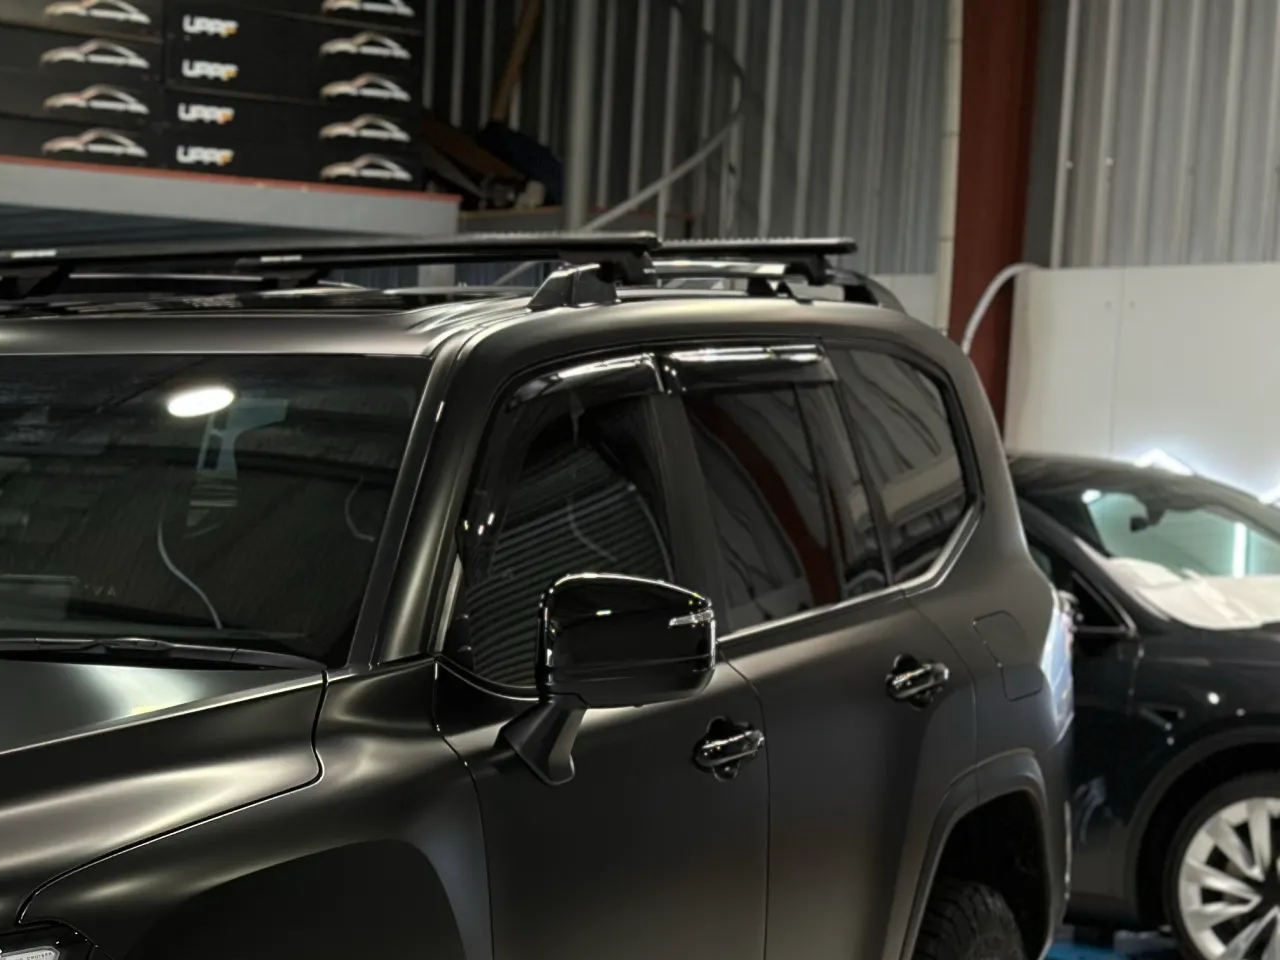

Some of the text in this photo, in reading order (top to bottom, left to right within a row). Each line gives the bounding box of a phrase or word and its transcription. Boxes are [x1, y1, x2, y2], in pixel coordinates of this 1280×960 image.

[182, 14, 239, 38] UPPF
[181, 58, 239, 82] UPPF
[178, 102, 235, 125] UPPF
[176, 144, 234, 167] UPPF
